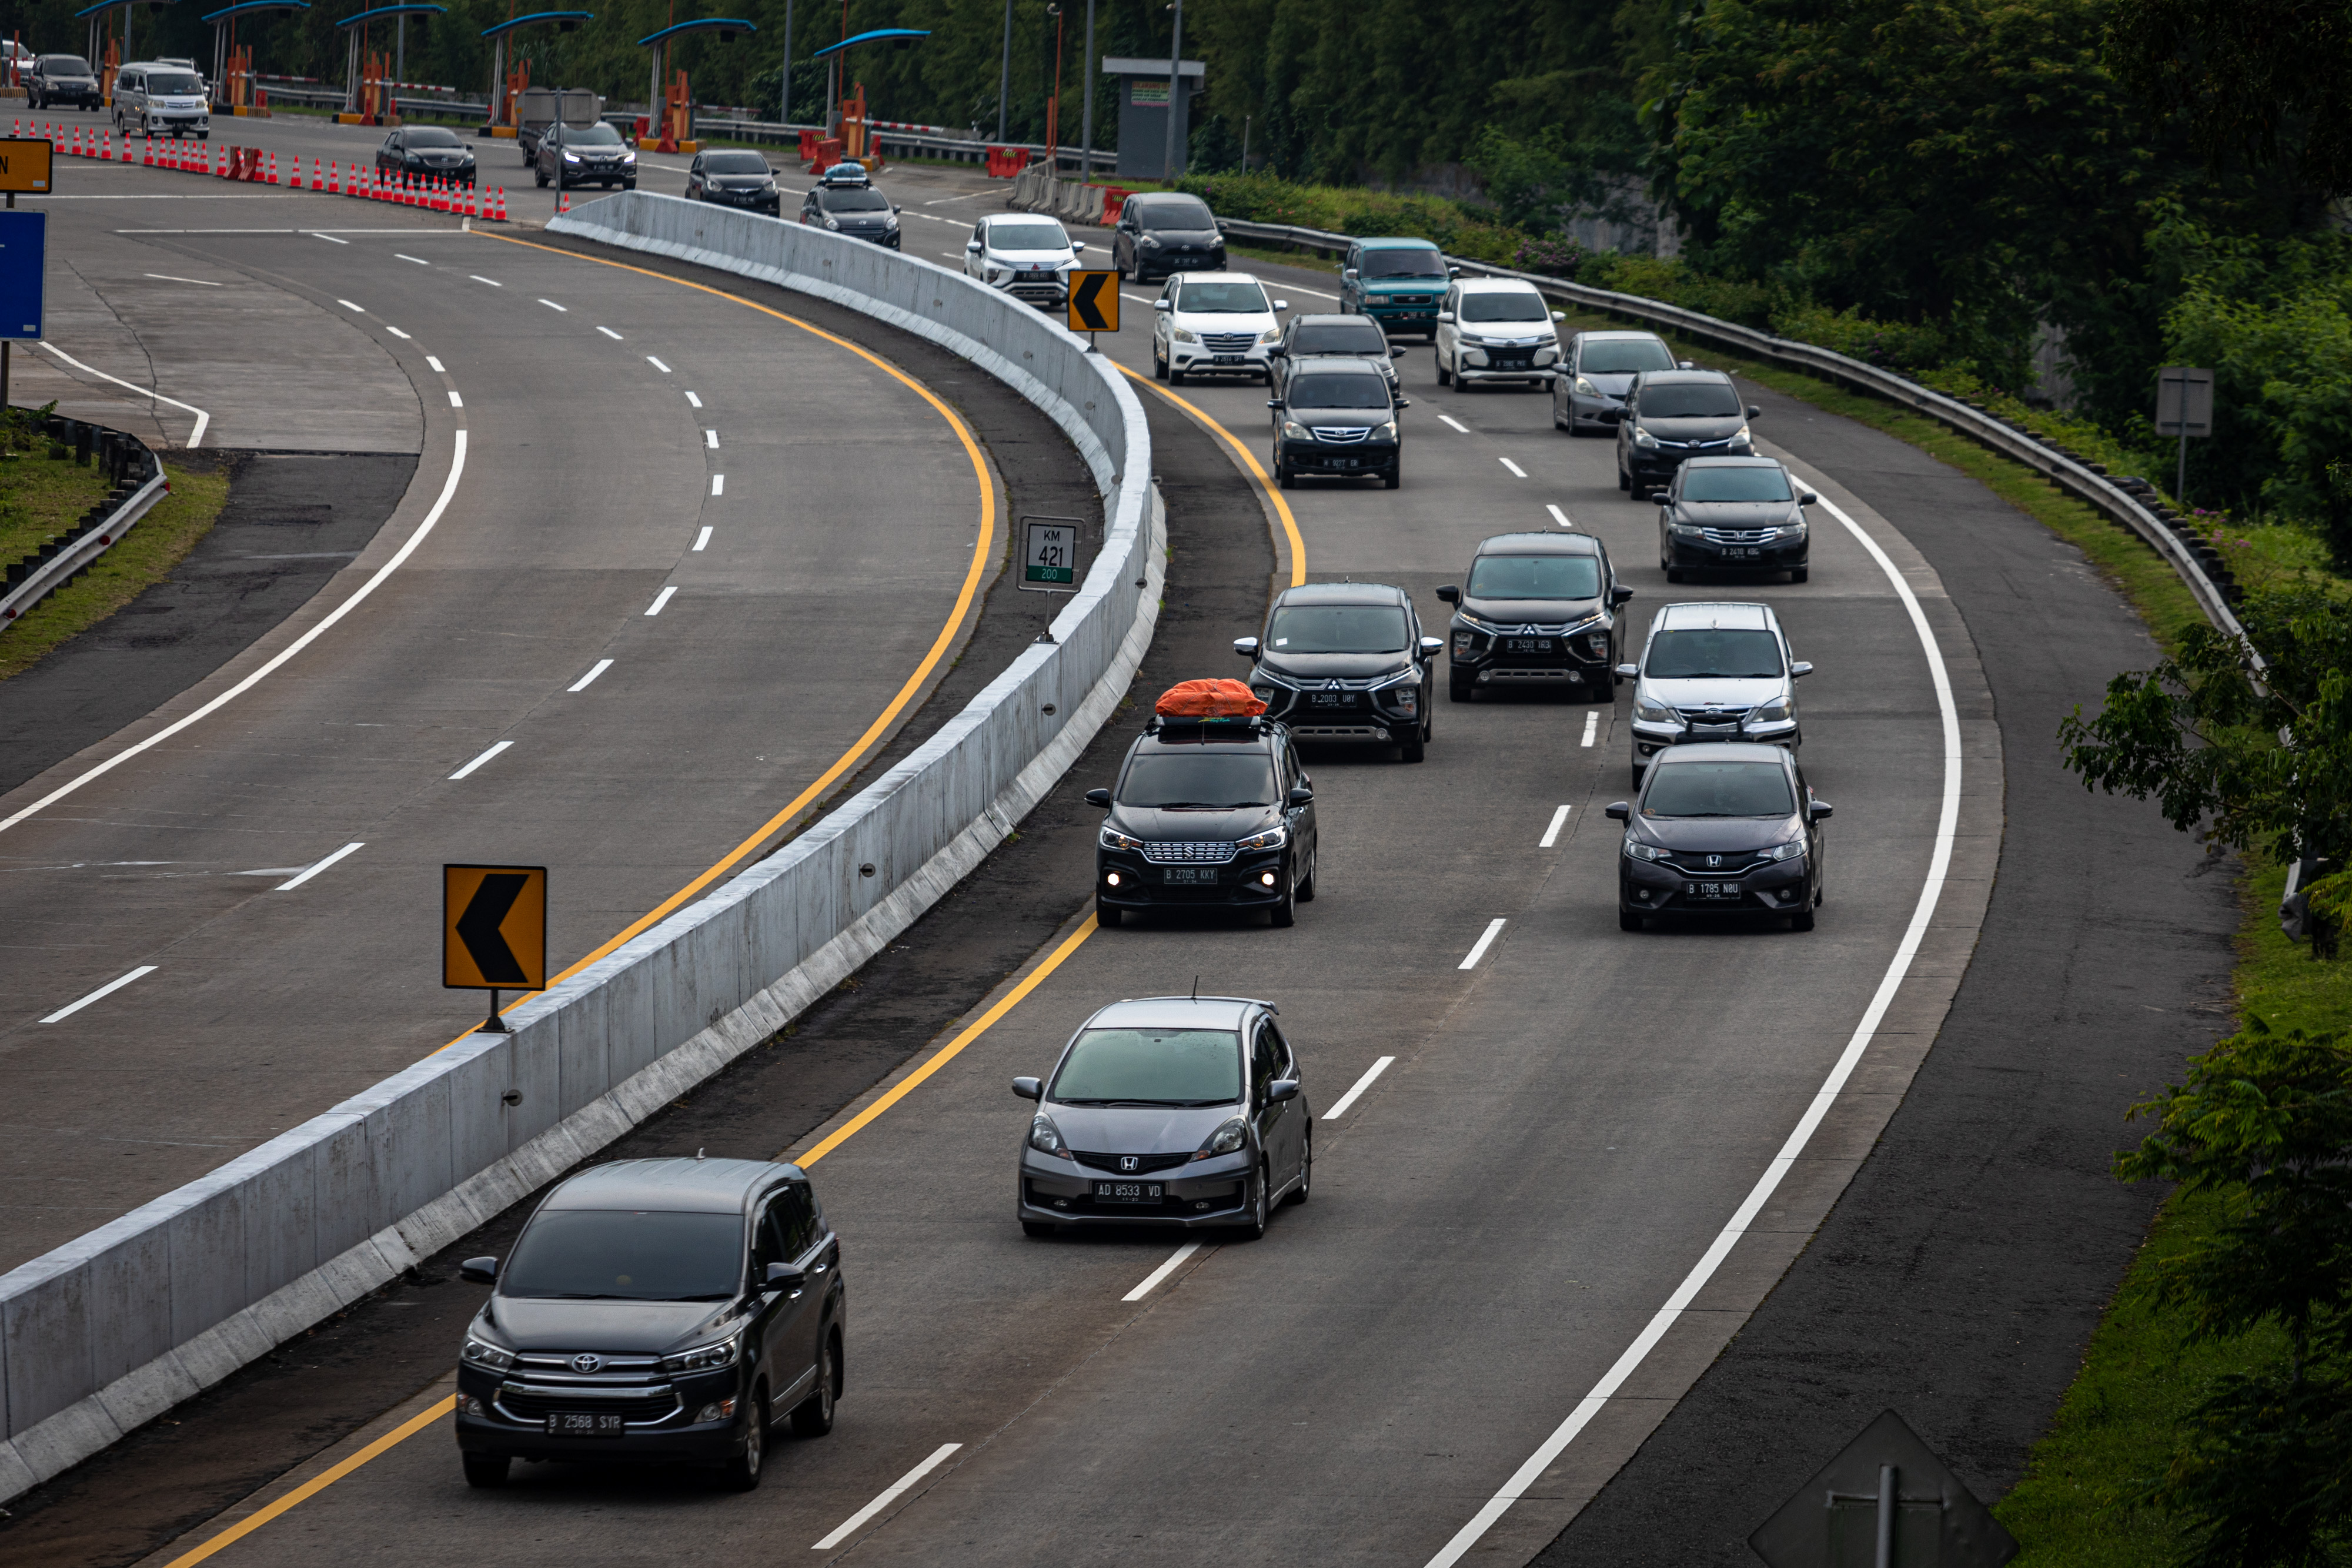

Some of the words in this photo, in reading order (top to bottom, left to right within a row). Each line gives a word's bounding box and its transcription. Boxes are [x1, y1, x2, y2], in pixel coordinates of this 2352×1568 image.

[1044, 530, 1060, 541] KM
[1038, 546, 1063, 567] 421
[1041, 568, 1057, 579] 200
[1312, 694, 1316, 703] B
[1320, 694, 1337, 703] 2003
[1166, 870, 1171, 879] B
[1176, 870, 1195, 879] 2705
[1200, 870, 1214, 879] KKY
[1689, 884, 1694, 894] B
[1700, 884, 1719, 893] 1785
[1098, 1184, 1111, 1195] AD
[1115, 1185, 1140, 1196] 8533
[1148, 1185, 1160, 1196] VD
[549, 1414, 557, 1427] B
[564, 1415, 592, 1428] 2568
[599, 1415, 620, 1429] SYR
